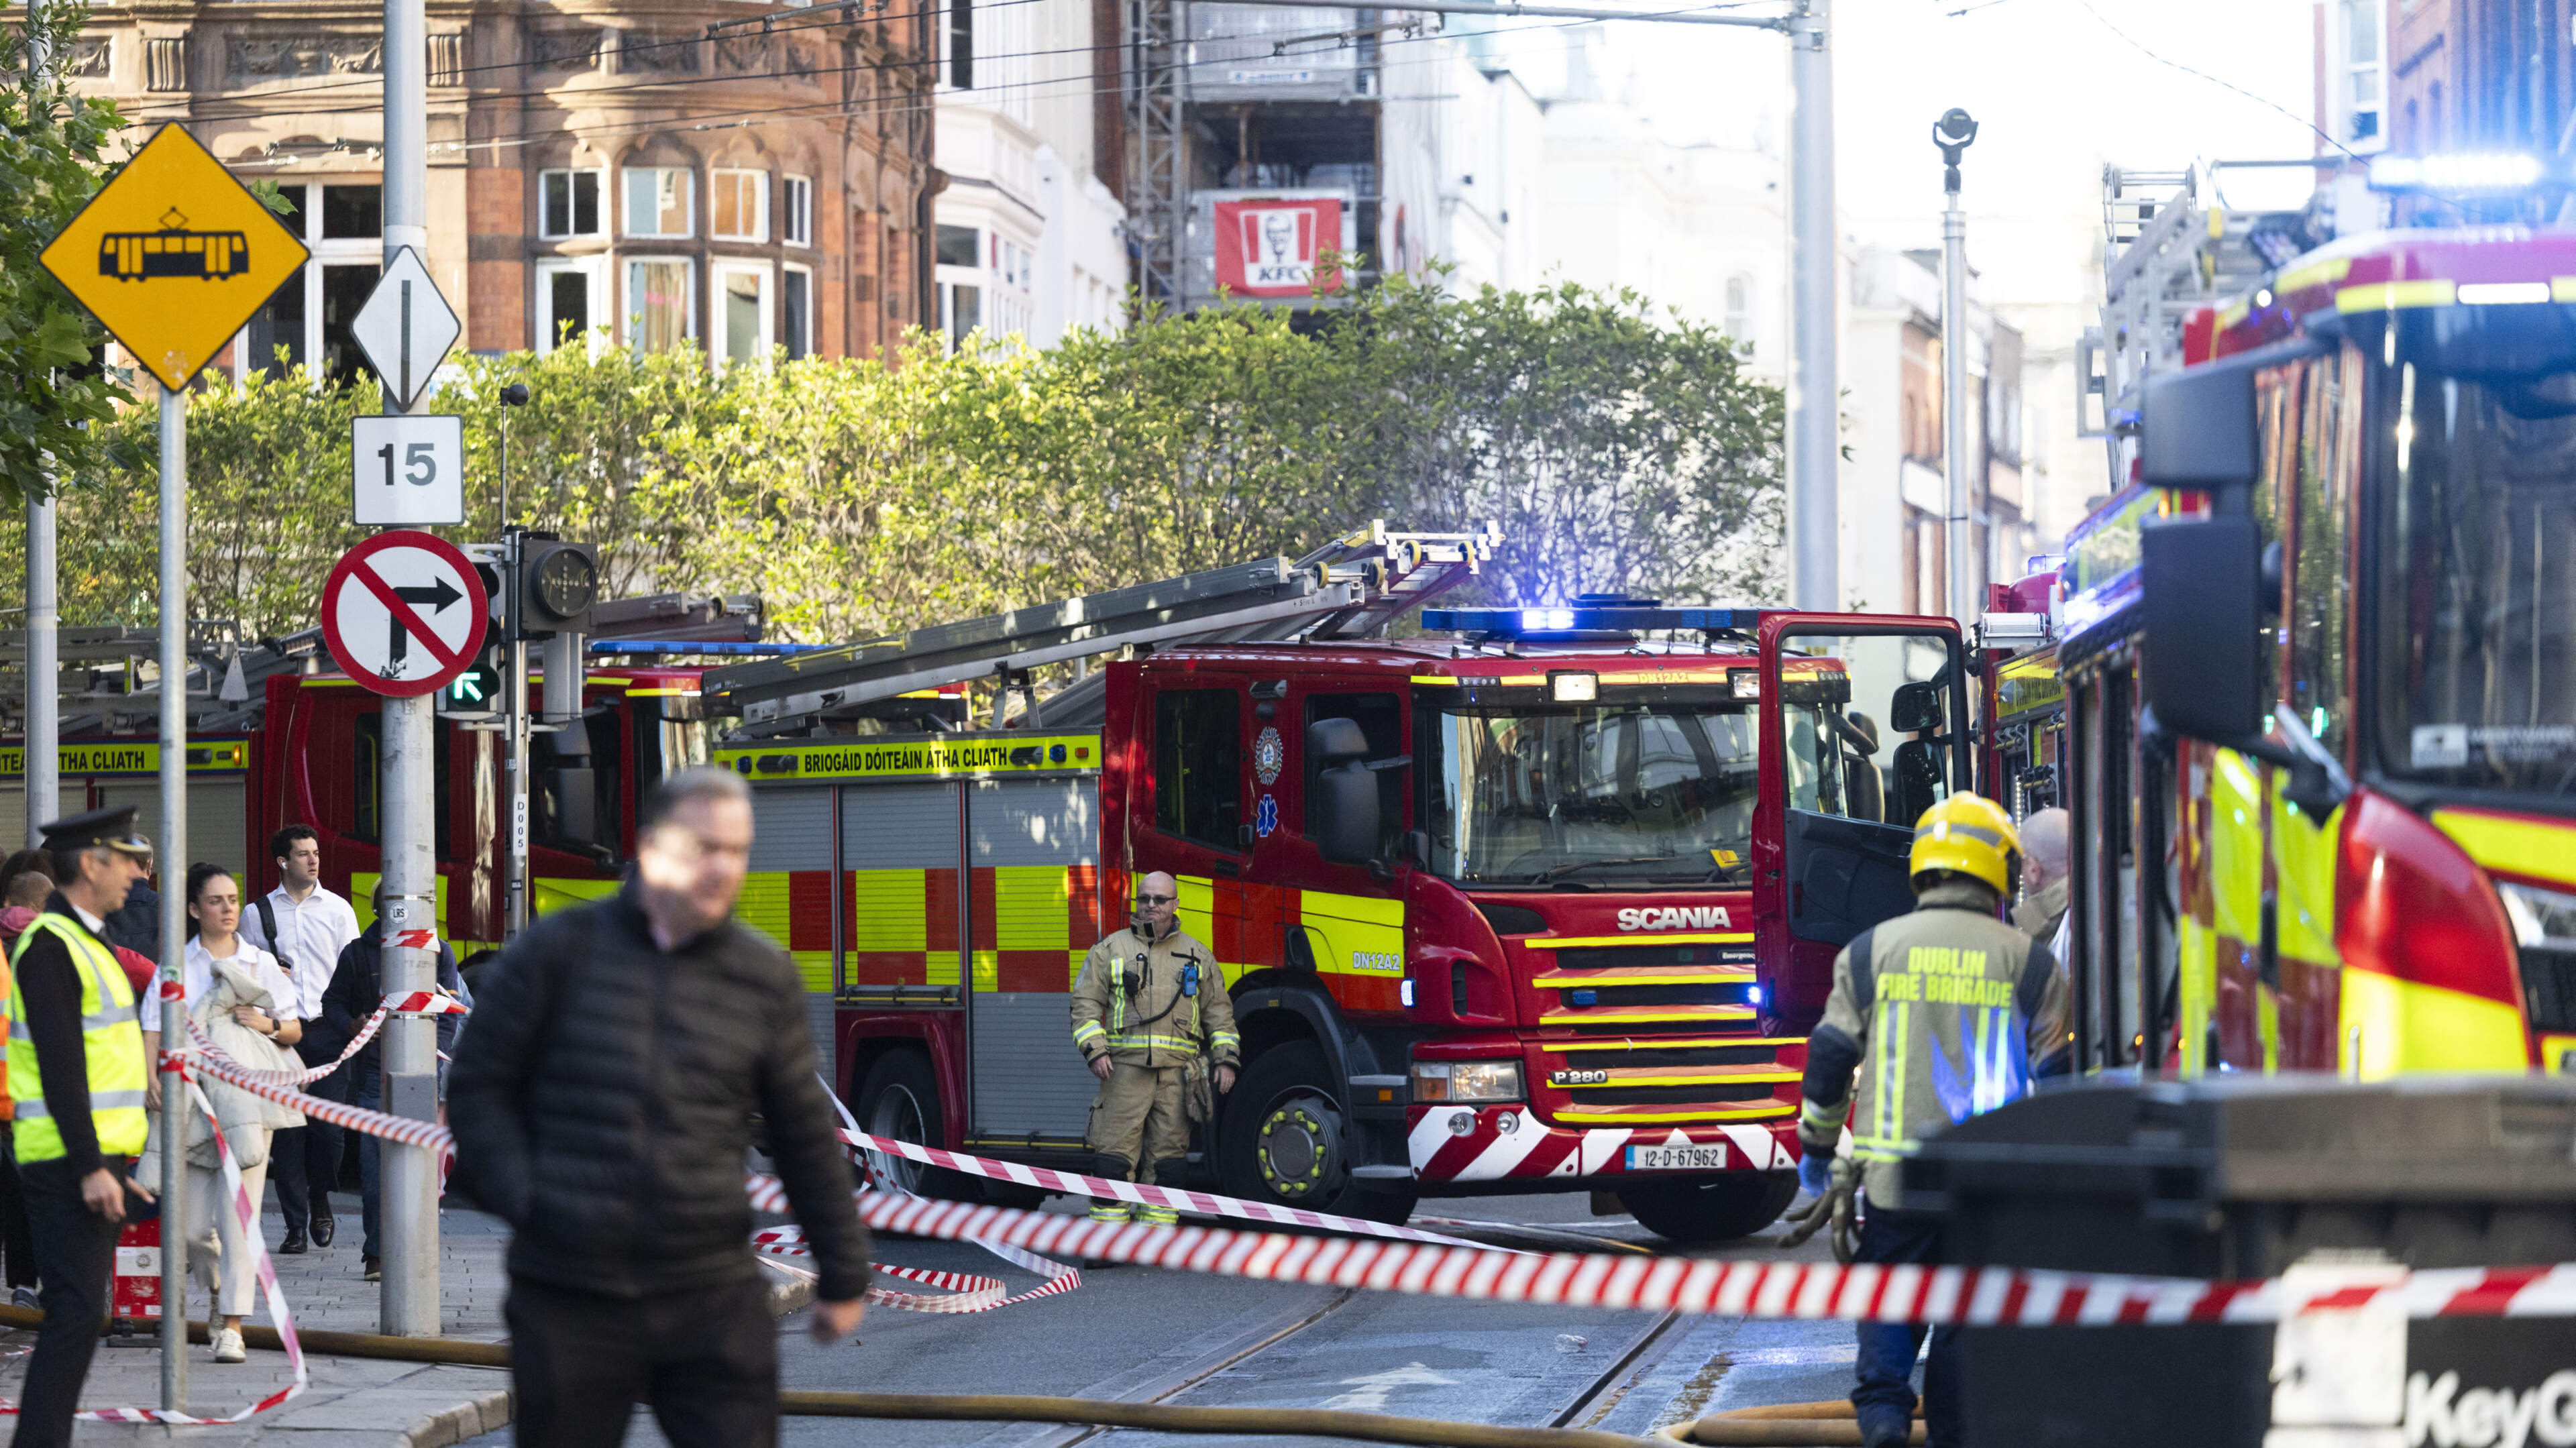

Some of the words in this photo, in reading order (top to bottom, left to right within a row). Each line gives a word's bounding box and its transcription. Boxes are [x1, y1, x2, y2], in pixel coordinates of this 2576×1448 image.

[1258, 267, 1301, 280] KFC
[378, 443, 437, 486] 15
[58, 752, 88, 770] THA
[93, 751, 145, 769] CLIATH
[804, 748, 861, 772] BRIOGÁID
[865, 747, 922, 770] DÓITEÁIN
[926, 746, 959, 769] ÁTHA
[963, 747, 1007, 767] CLIATH
[1617, 907, 1731, 931] SCANIA
[1353, 951, 1400, 971] DN12A2
[1907, 946, 1987, 978] DUBLIN
[1876, 972, 1922, 1002] FIRE
[1924, 974, 2014, 1007] BRIGADE
[1555, 1072, 1566, 1084] P
[1569, 1070, 1606, 1084] 280
[1645, 1149, 1718, 1167] 12-D-67962
